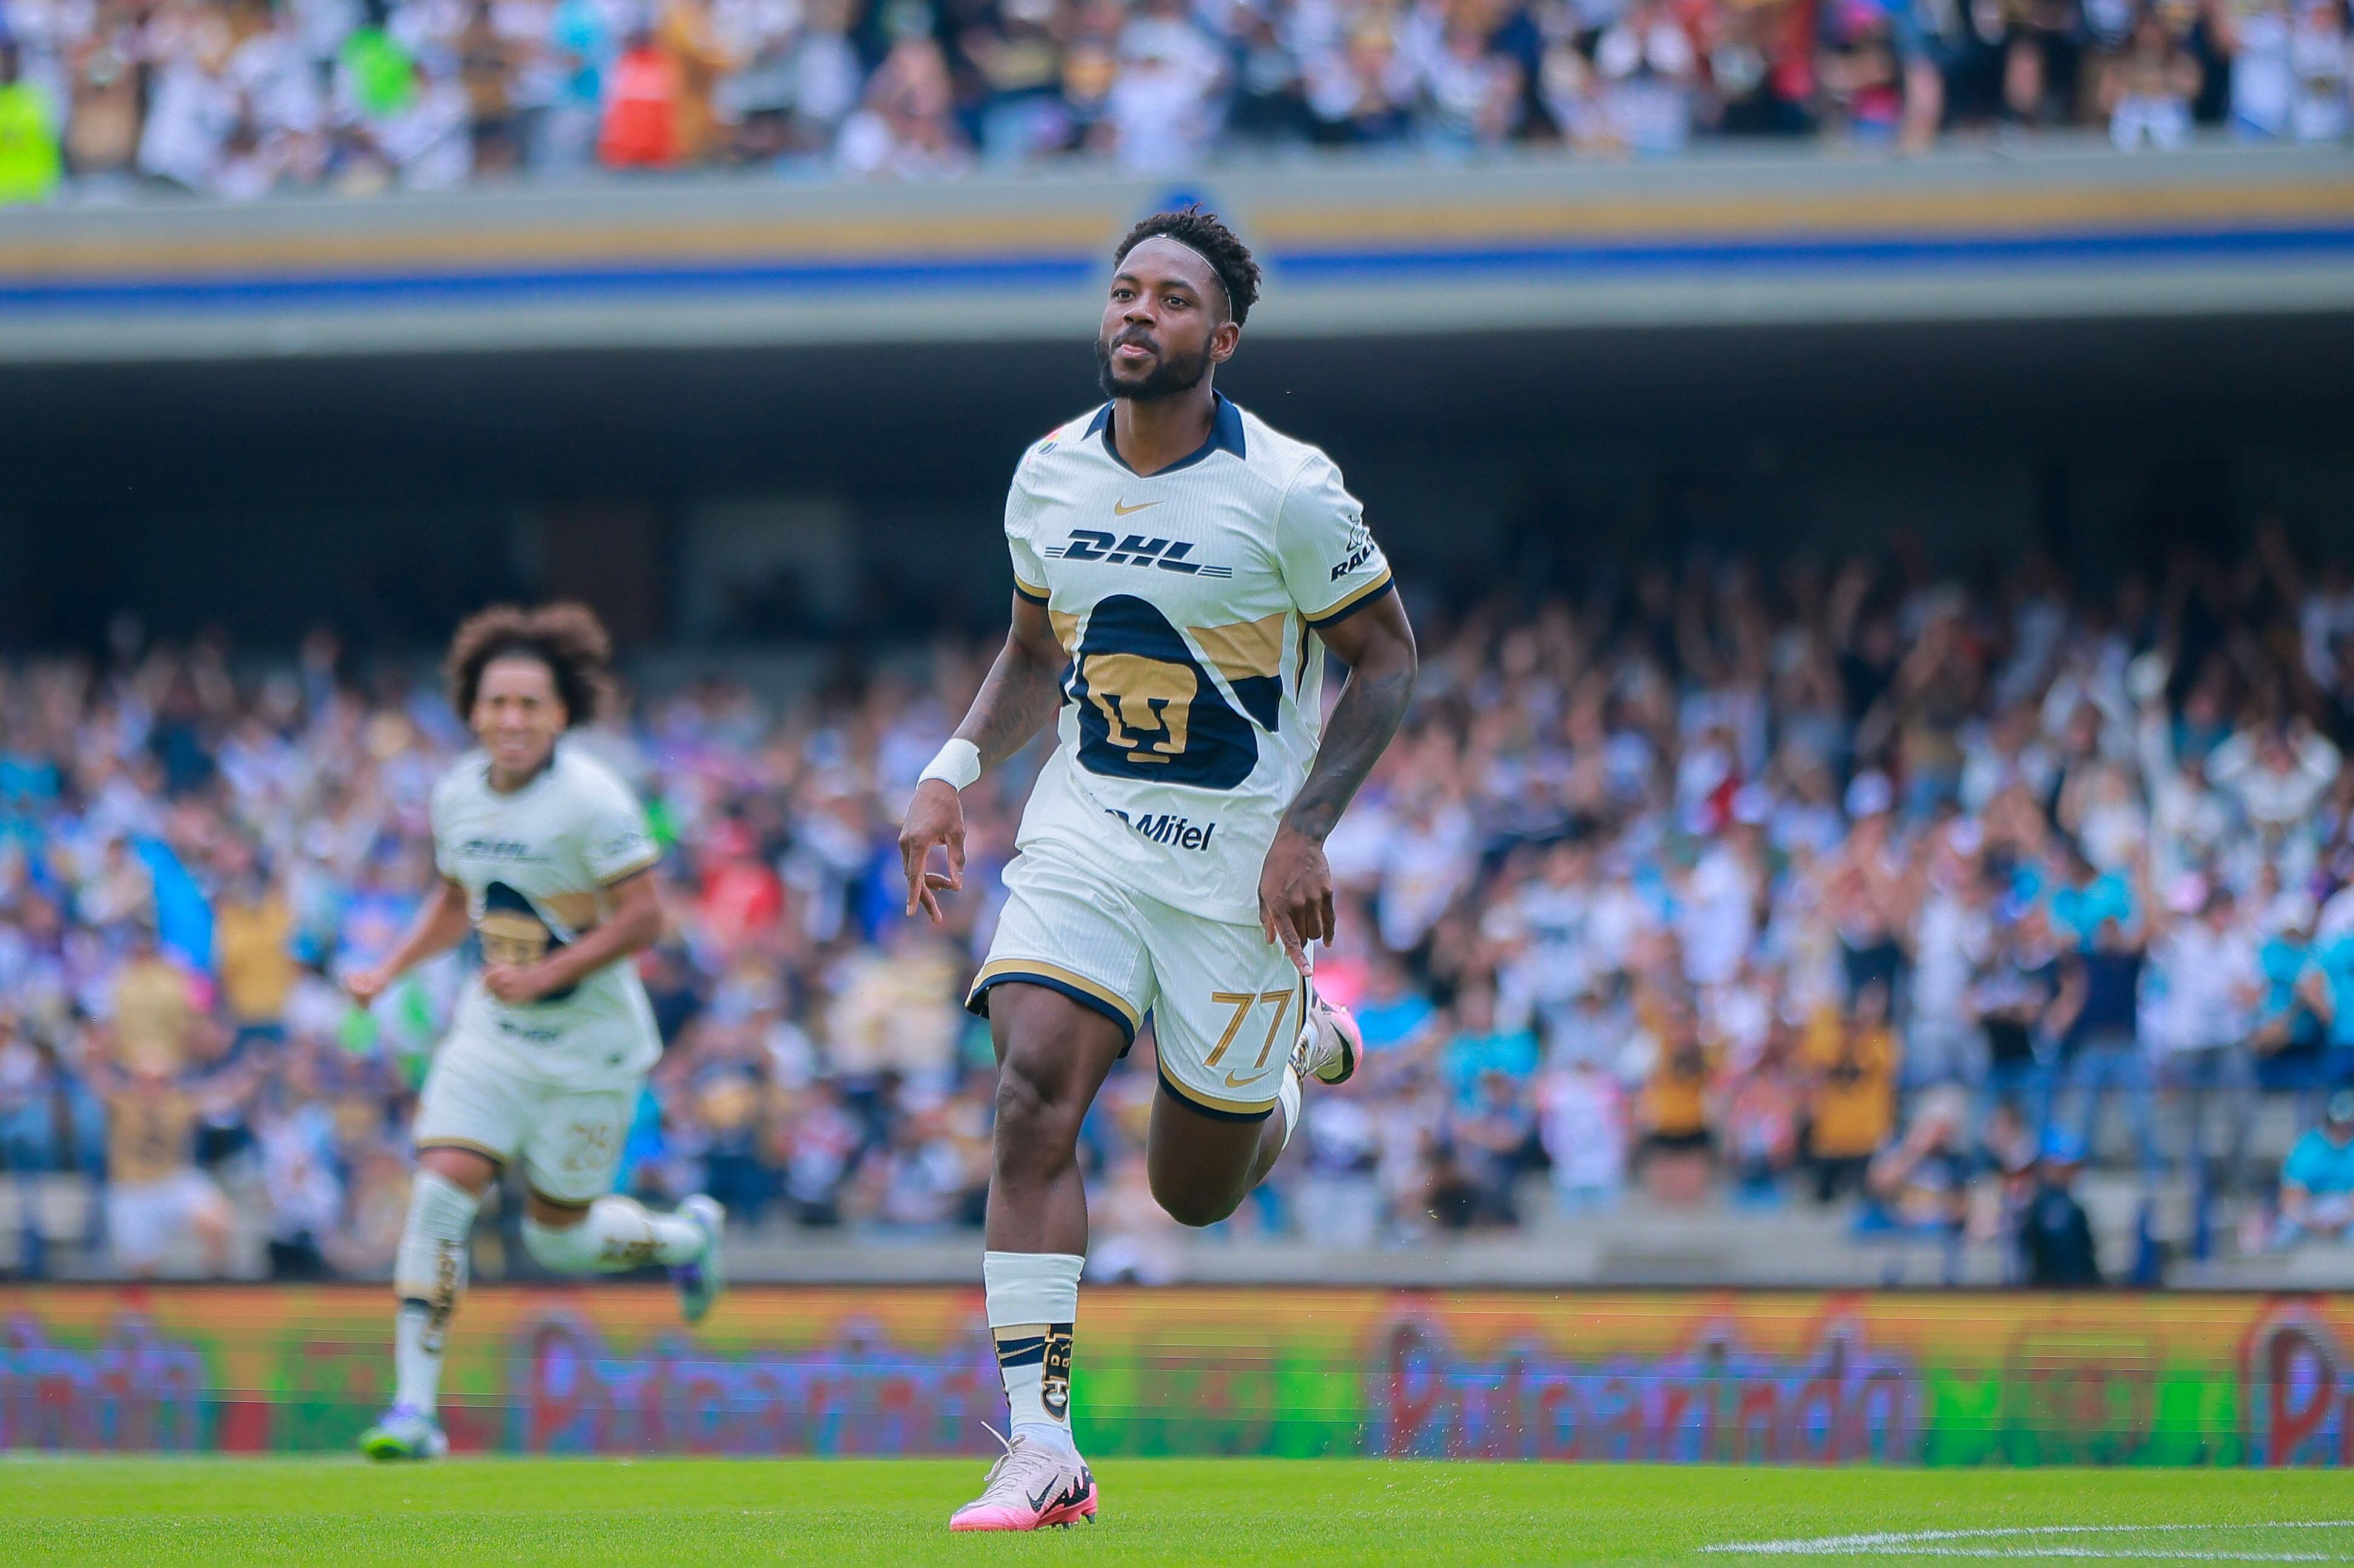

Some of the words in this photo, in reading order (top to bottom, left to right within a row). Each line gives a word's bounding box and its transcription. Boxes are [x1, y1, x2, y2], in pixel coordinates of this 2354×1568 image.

[1062, 529, 1202, 576] DHL
[1135, 814, 1216, 852] Mifel
[1203, 989, 1294, 1068] 77
